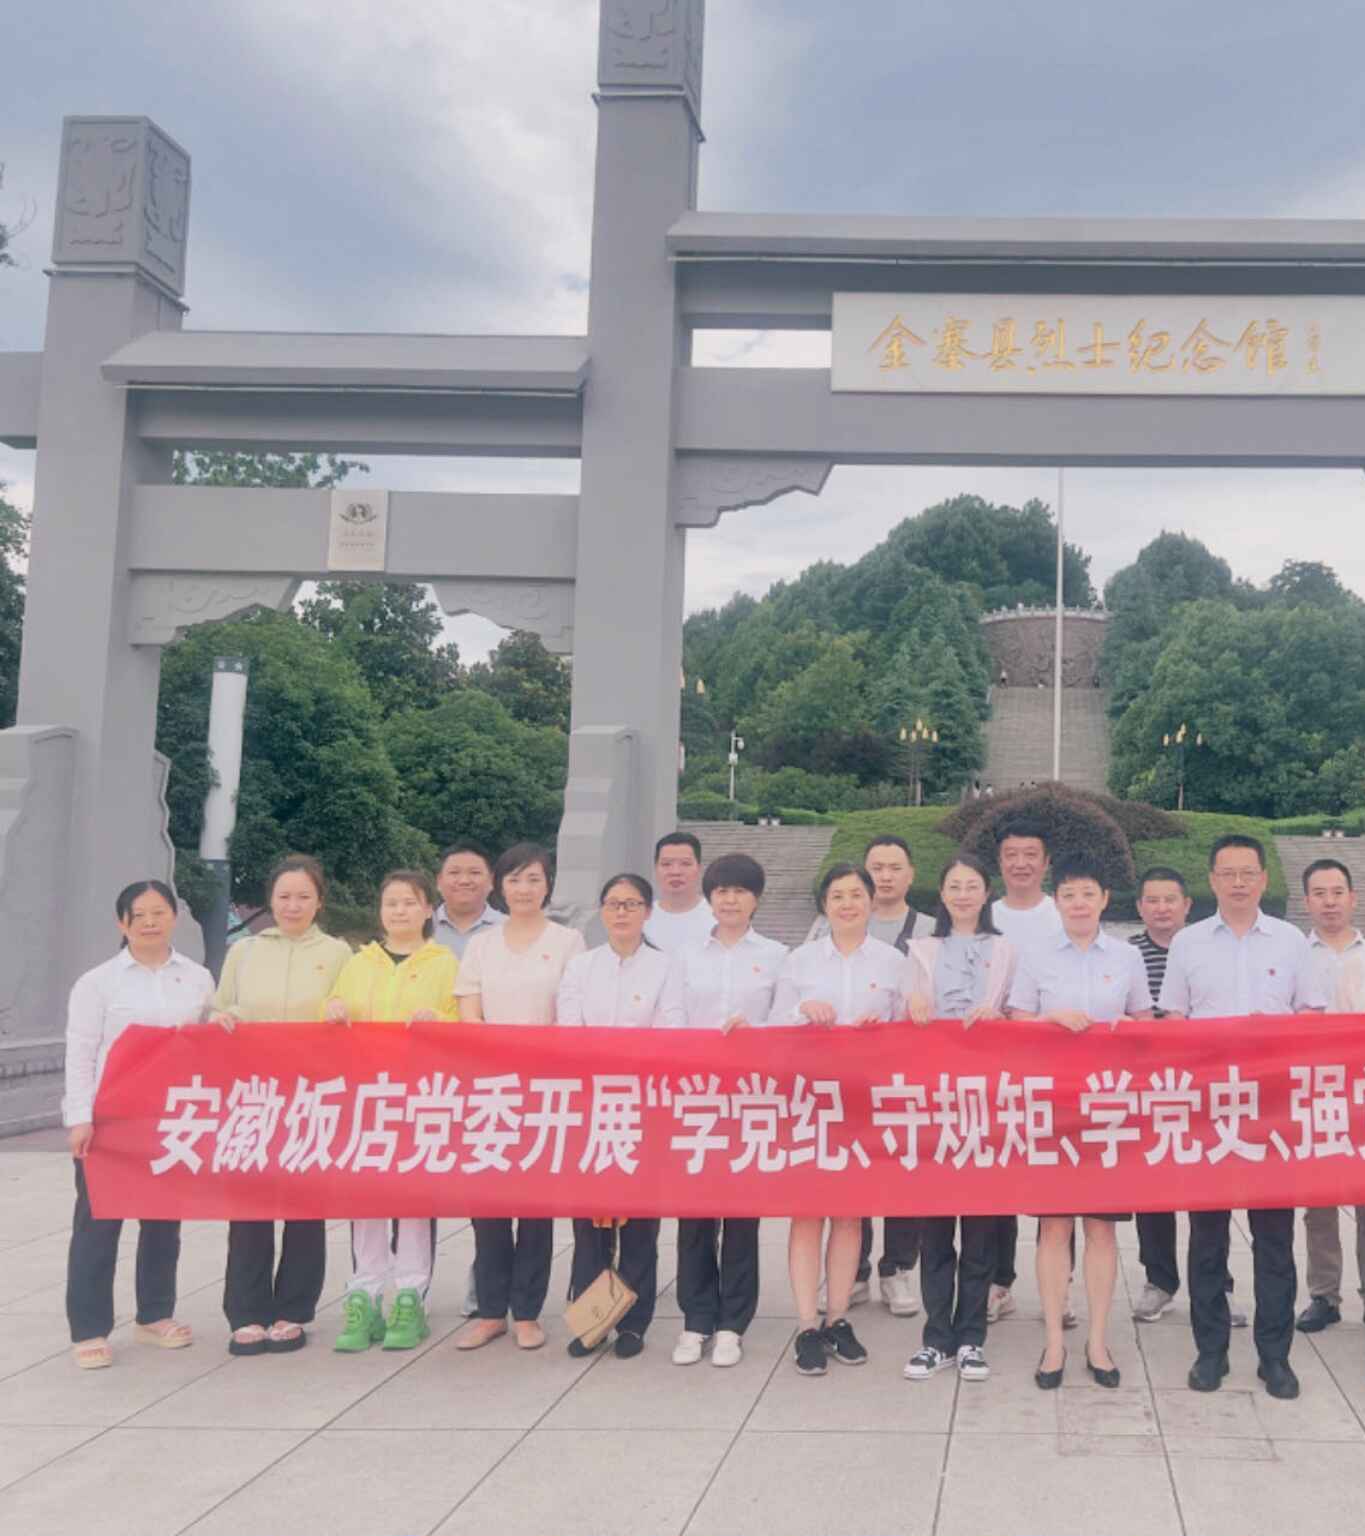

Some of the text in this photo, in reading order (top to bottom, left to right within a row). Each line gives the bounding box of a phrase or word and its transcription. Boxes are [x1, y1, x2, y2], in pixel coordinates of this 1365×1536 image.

[868, 313, 1290, 375] 金寨县烈士纪念馆
